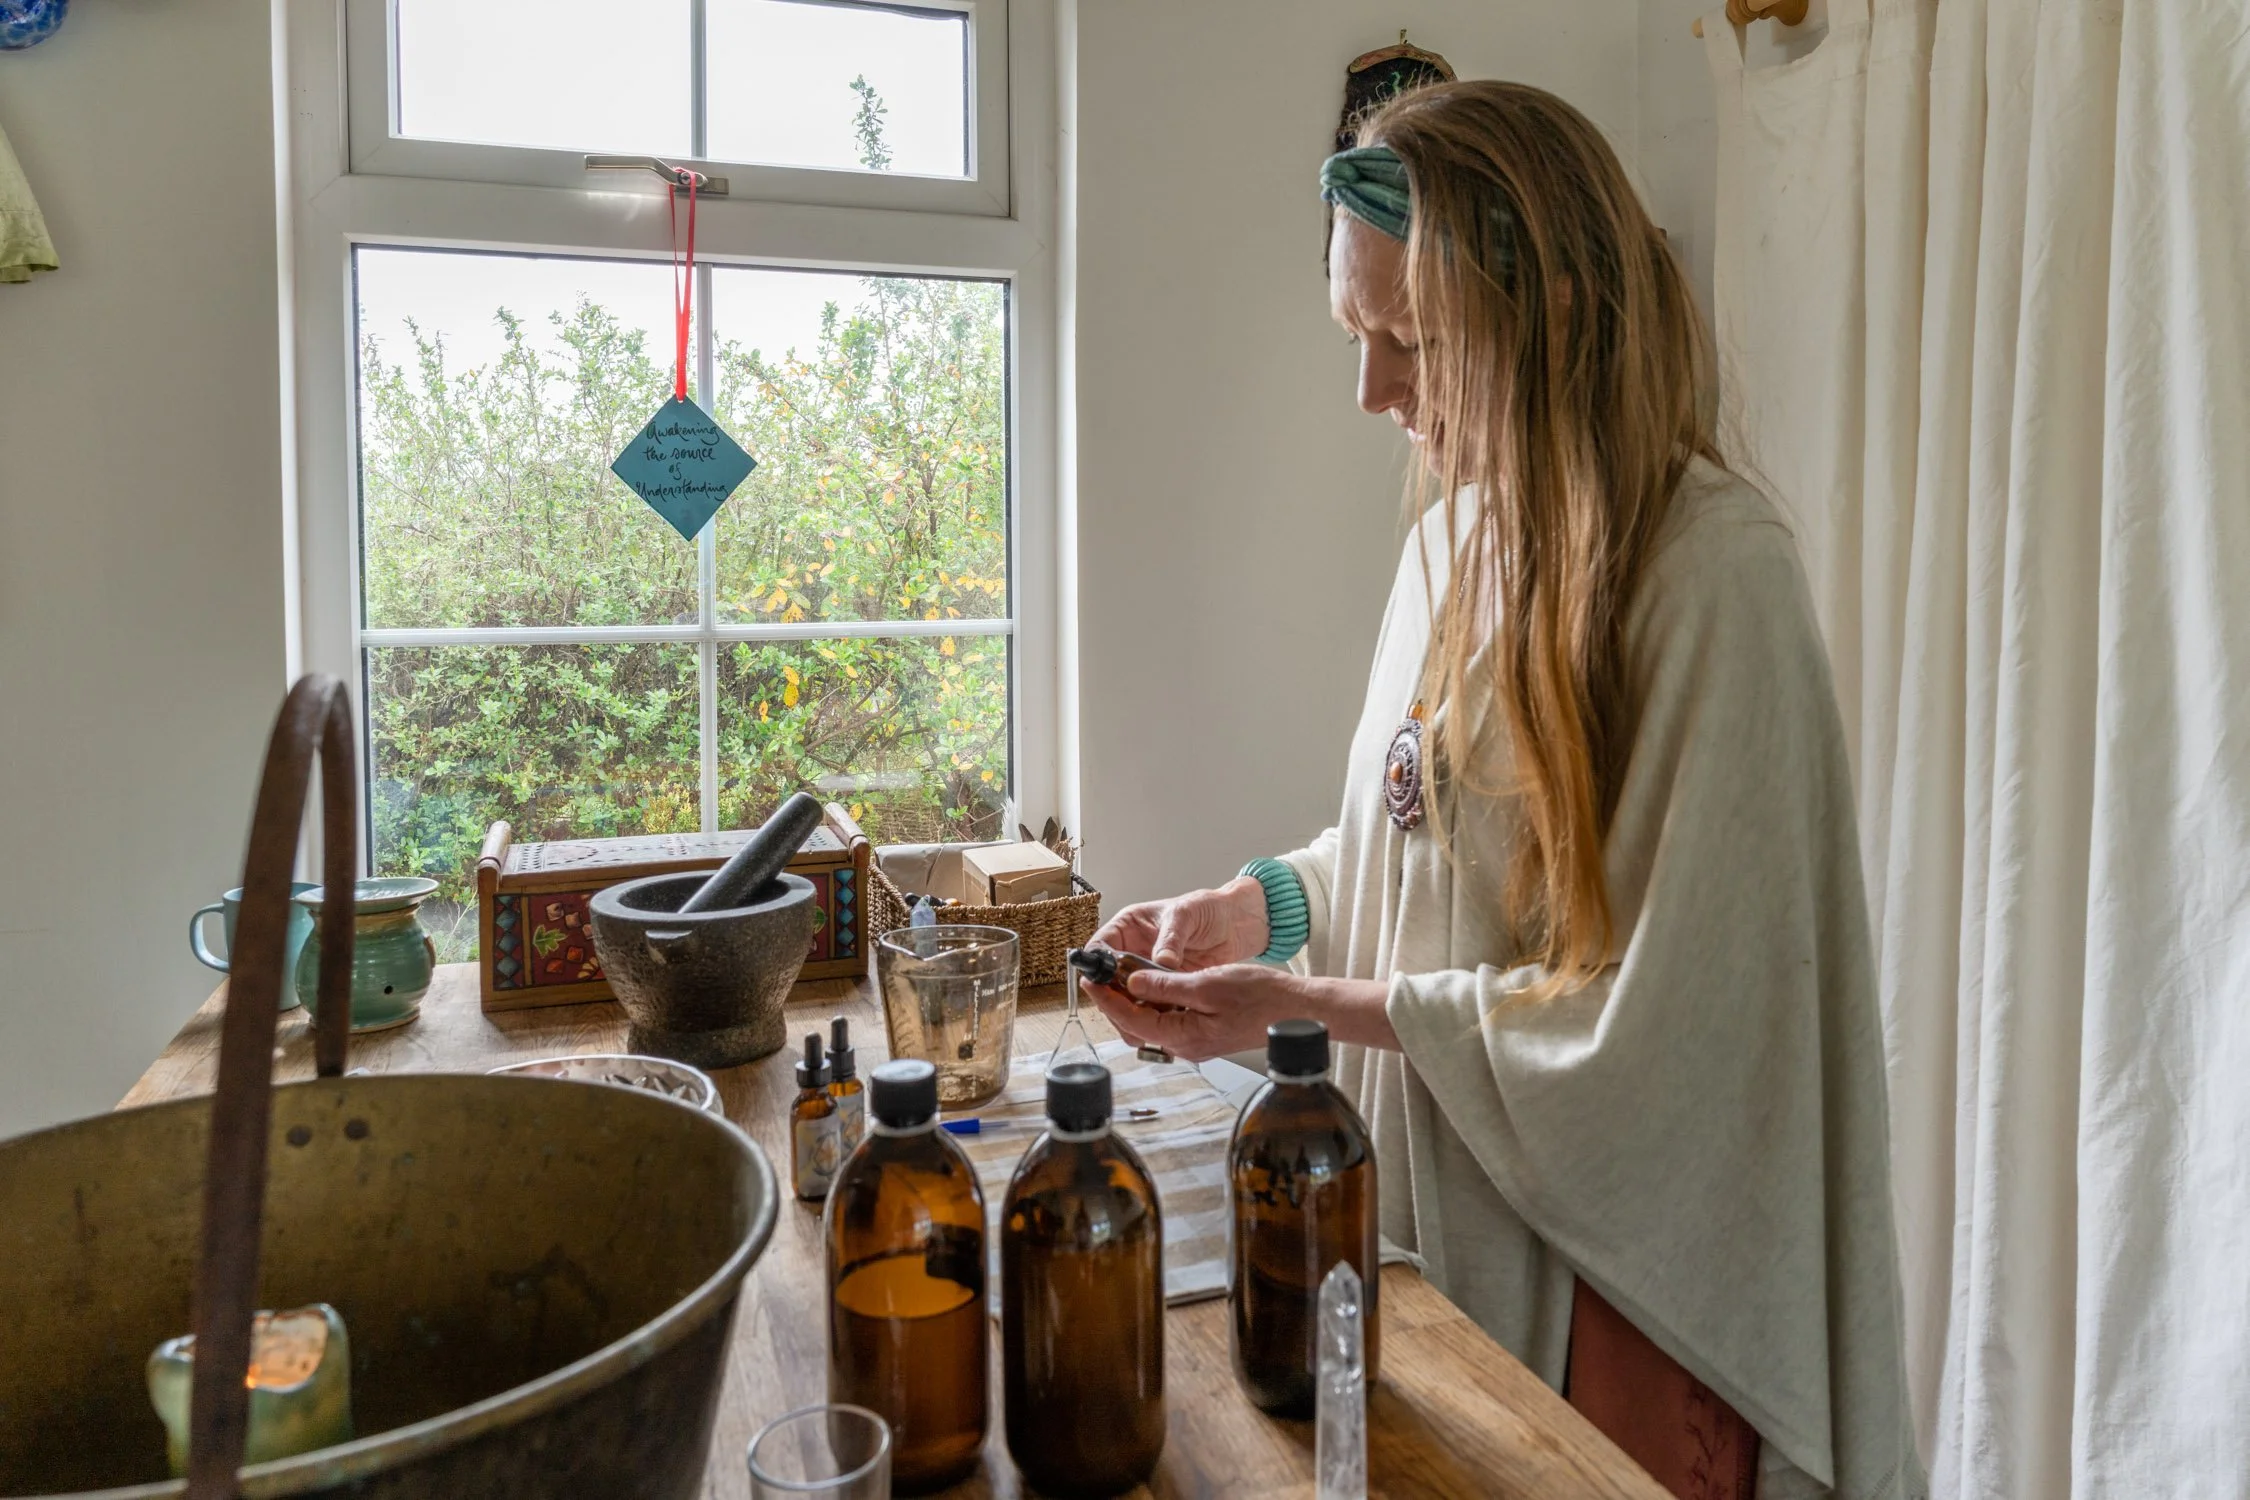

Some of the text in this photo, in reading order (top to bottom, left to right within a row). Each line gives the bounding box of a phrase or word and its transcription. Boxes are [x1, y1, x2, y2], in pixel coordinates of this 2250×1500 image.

[643, 446, 717, 463] the source
[668, 462, 682, 480] of
[636, 479, 729, 503] Understanding
